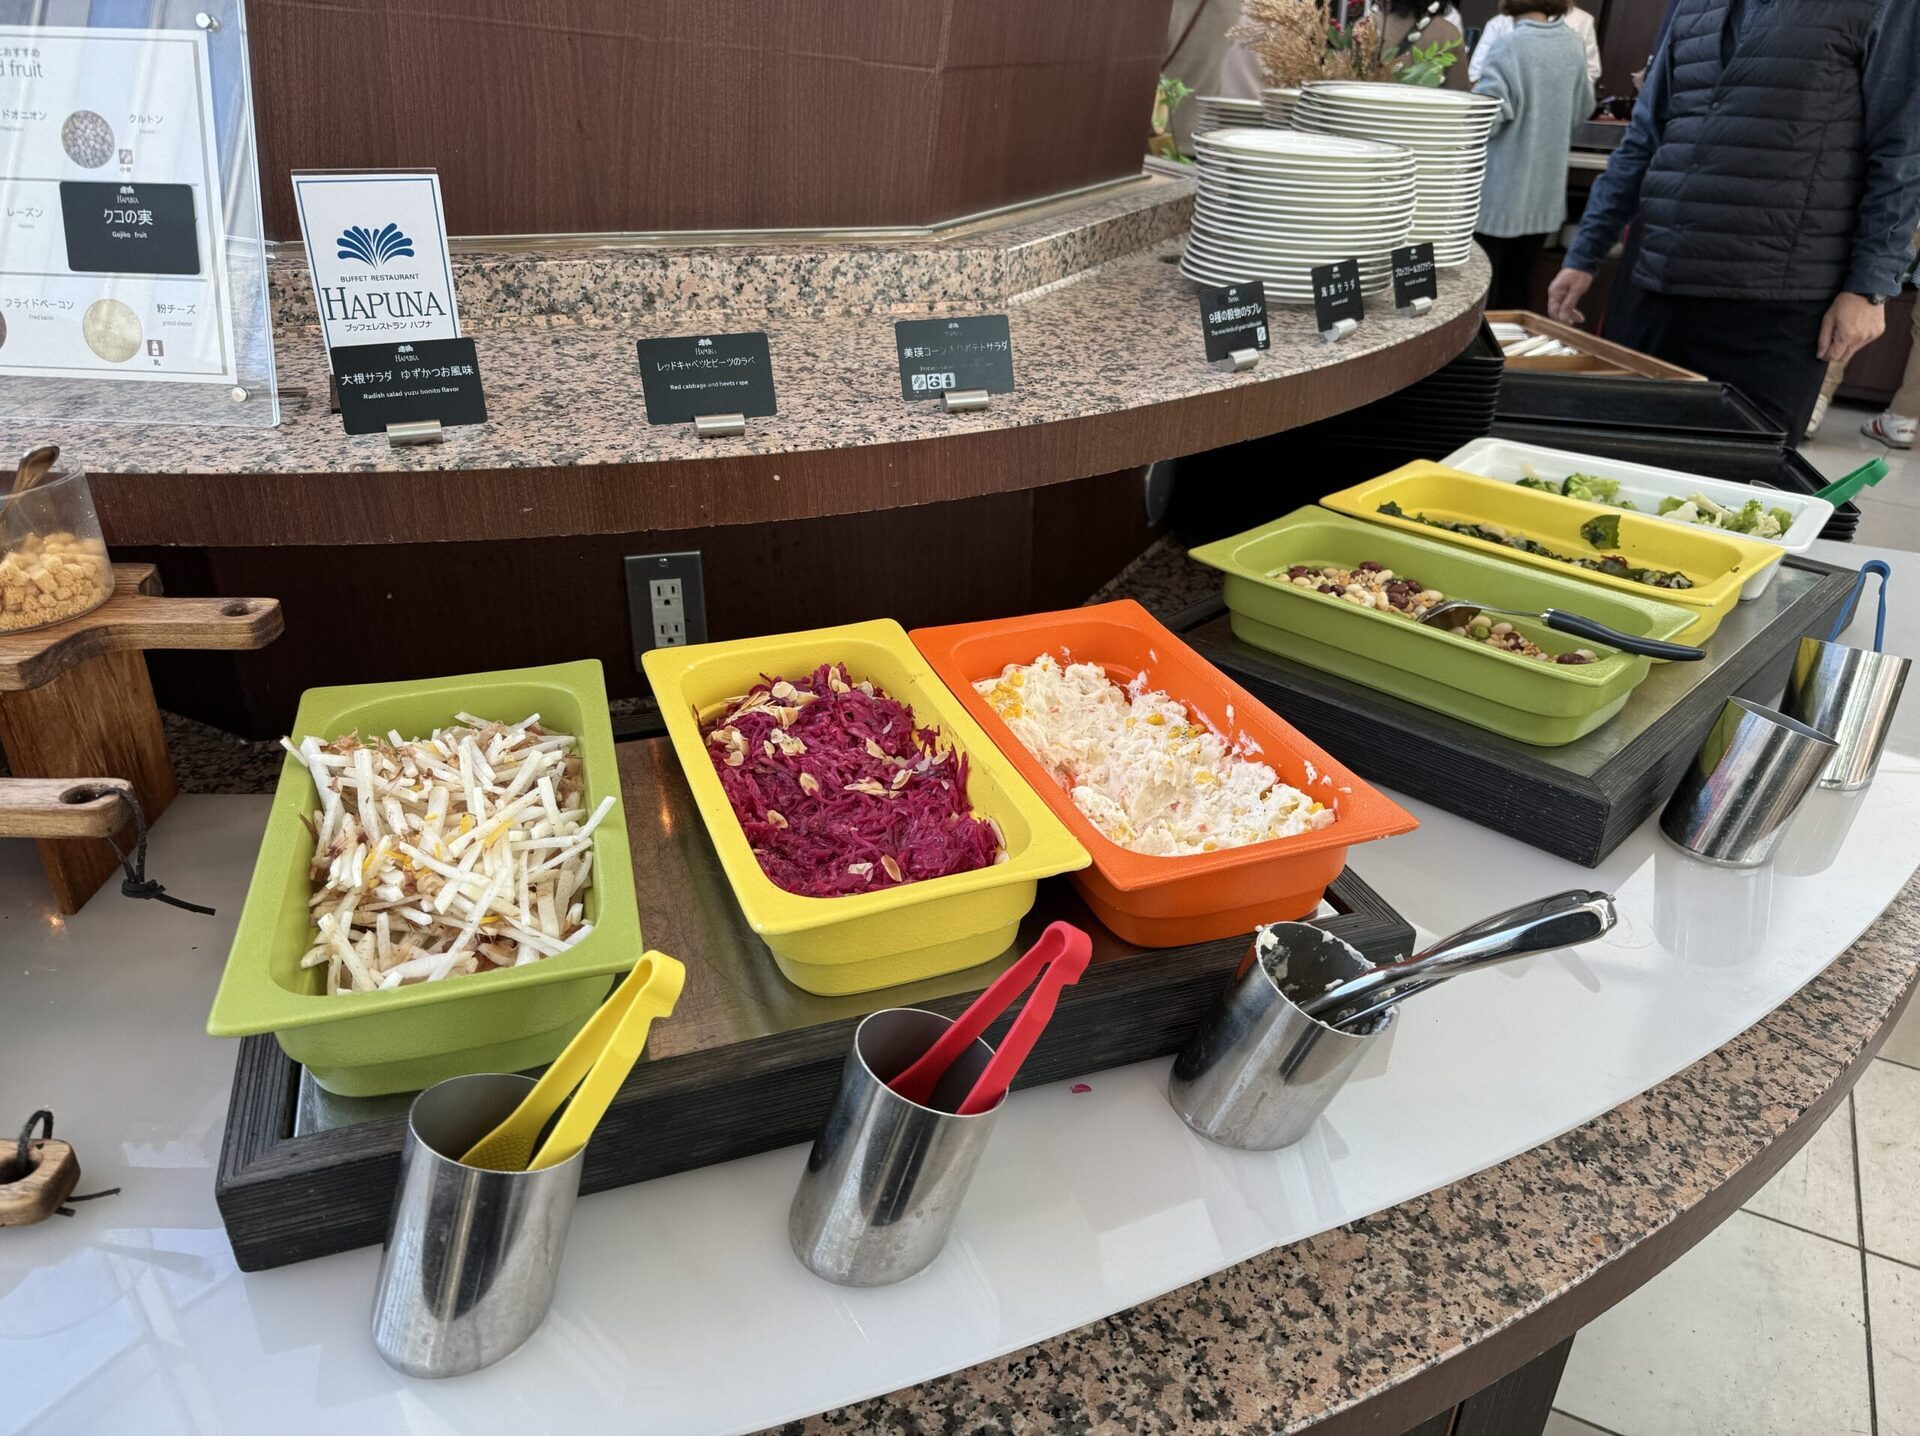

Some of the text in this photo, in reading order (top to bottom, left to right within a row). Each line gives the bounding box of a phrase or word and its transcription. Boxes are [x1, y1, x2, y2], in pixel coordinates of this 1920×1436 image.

[10, 59, 44, 78] fruit
[129, 113, 164, 124] クルトン
[7, 207, 44, 218] レーズン
[103, 208, 153, 225] クコの実
[134, 231, 148, 239] fruit
[340, 273, 420, 283] BUFFET RESTAURANT
[4, 297, 74, 310] フライドベーコン
[156, 303, 196, 315] 粉チーズ
[321, 286, 447, 321] HAPUNA
[345, 321, 407, 332] ブッフェレストラン
[340, 364, 474, 386] 大根サラダ ゆずかつお風味
[682, 382, 706, 390] cabbage
[363, 392, 386, 400] Radish
[386, 390, 403, 398] salad
